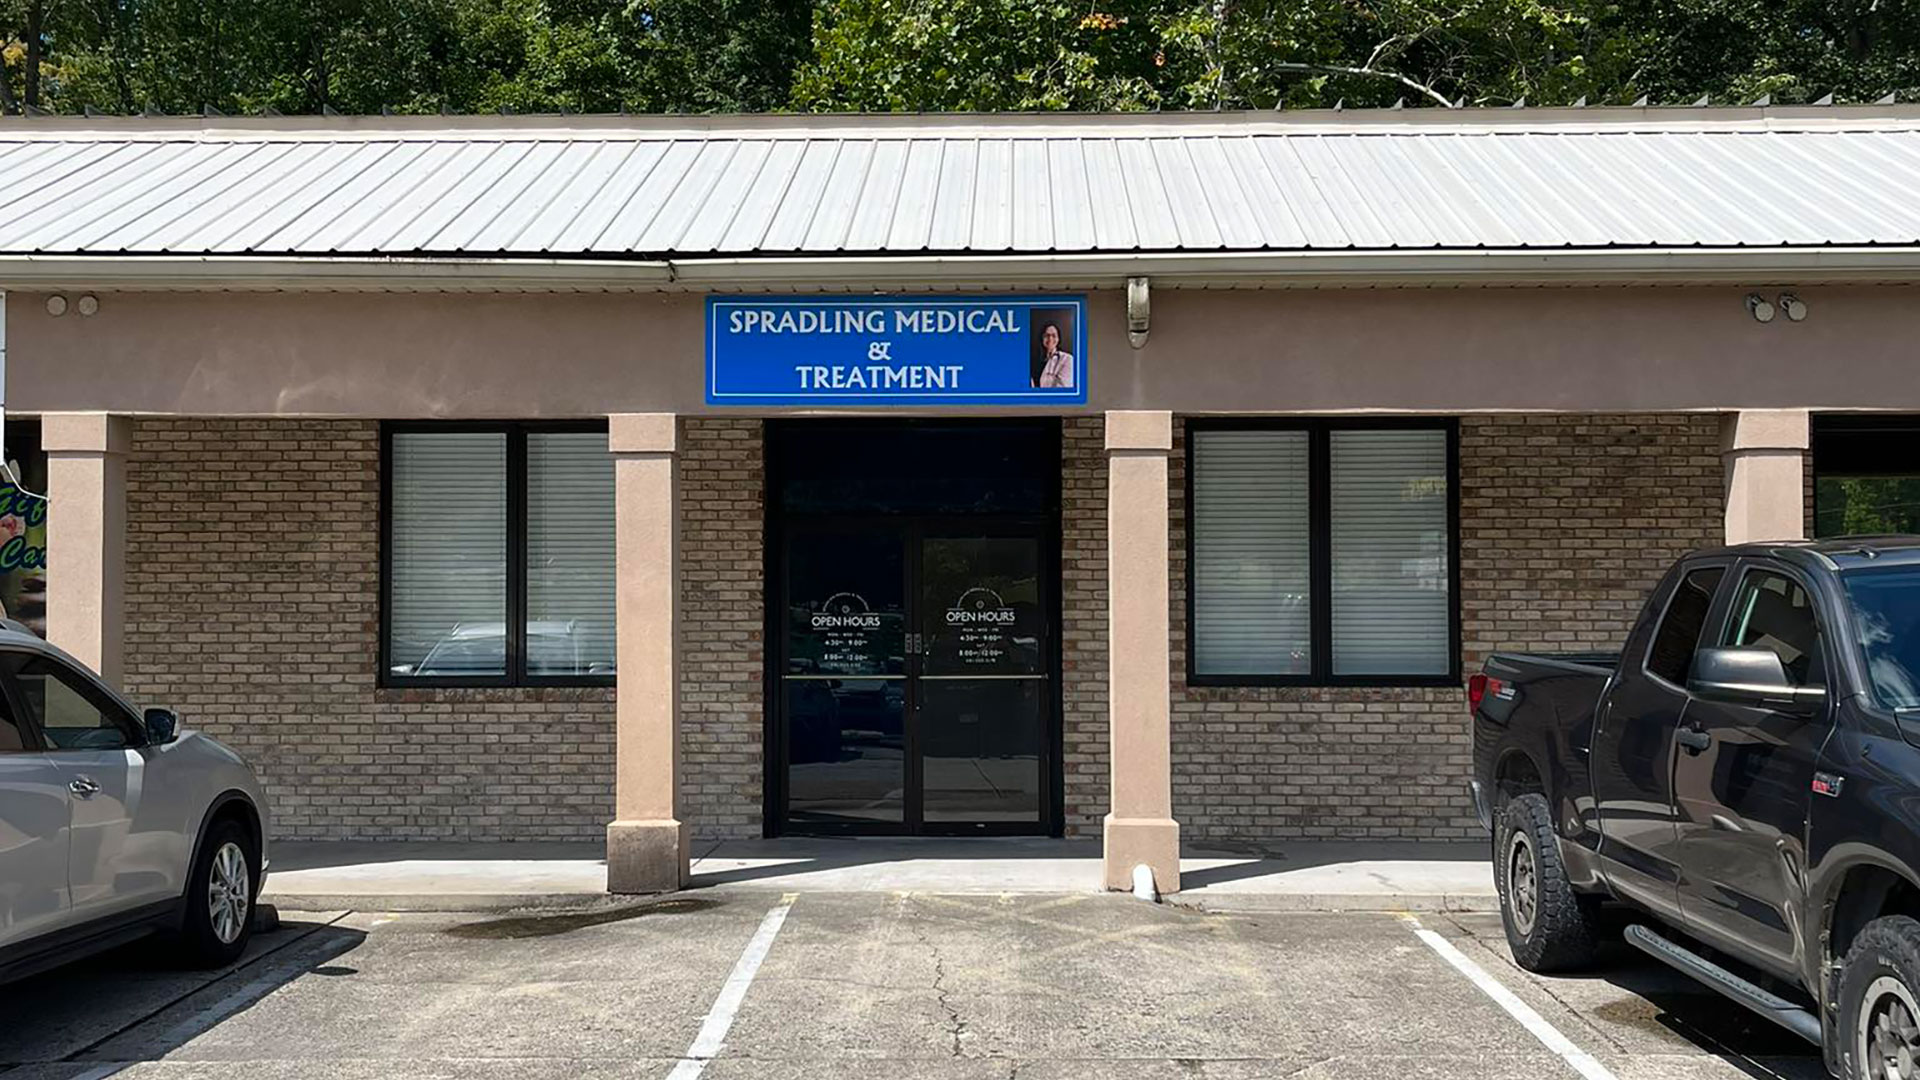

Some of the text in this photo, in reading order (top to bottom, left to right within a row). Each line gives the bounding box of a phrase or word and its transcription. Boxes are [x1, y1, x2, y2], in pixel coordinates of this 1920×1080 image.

[730, 309, 1021, 333] SPRADLING MEDICAL
[867, 341, 892, 361] &
[795, 365, 964, 389] TREATMENT
[811, 616, 881, 627] OPEN HOURS
[946, 611, 1015, 622] OPEN HOURS
